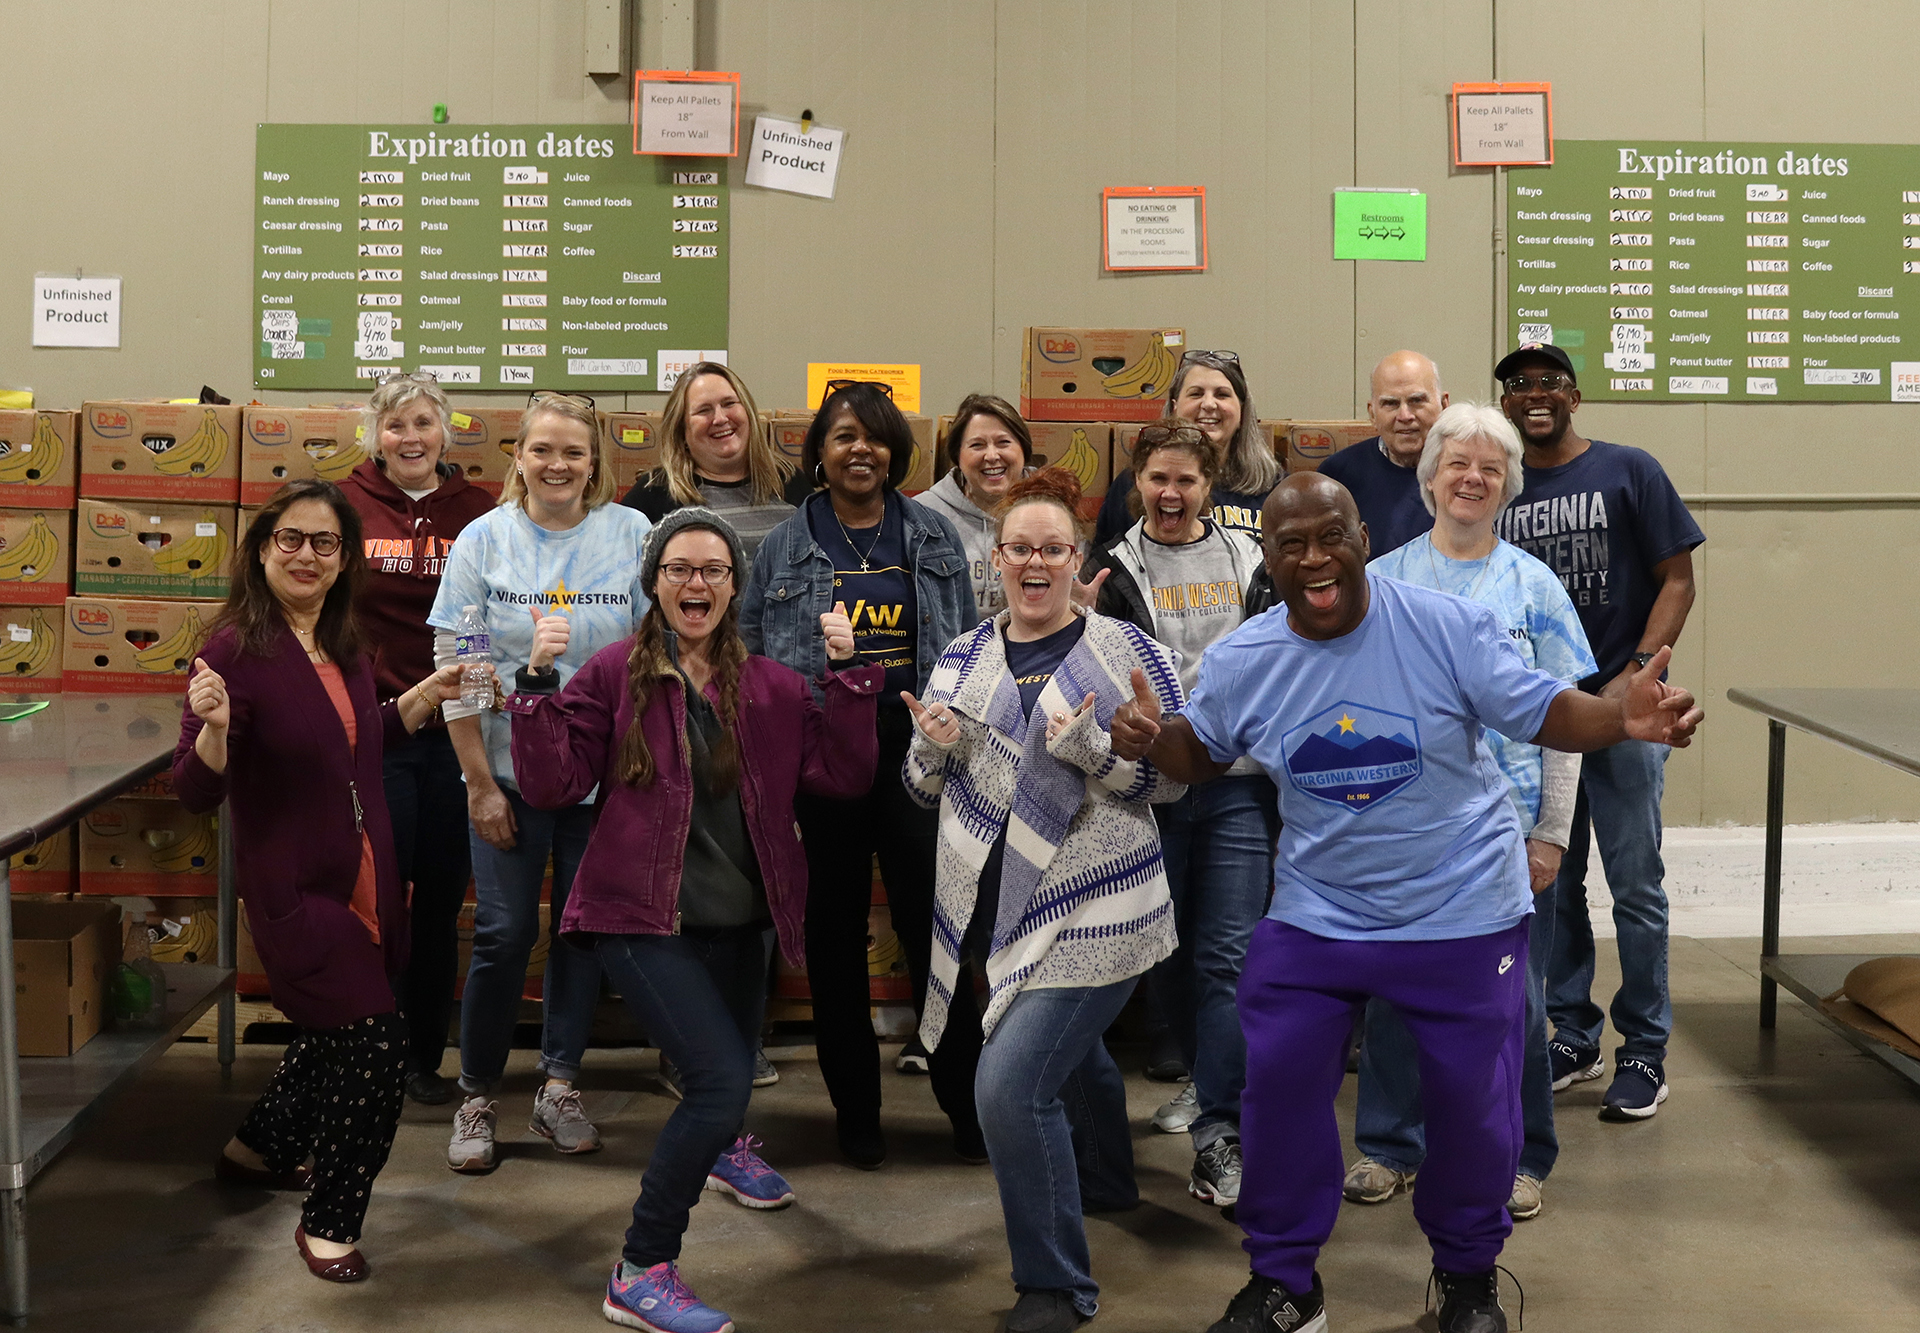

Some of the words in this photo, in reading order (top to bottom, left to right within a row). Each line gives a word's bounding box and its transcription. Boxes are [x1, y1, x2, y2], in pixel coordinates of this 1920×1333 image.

[651, 96, 674, 104] Keep
[677, 96, 688, 104] All
[691, 96, 721, 106] Pallets
[1467, 107, 1489, 116] Keep
[1504, 107, 1533, 115] Pallets
[662, 130, 685, 138] From
[688, 130, 709, 139] Wall
[763, 129, 833, 151] Unfinished
[1479, 140, 1501, 148] From
[368, 131, 527, 164] Expiration
[537, 132, 614, 158] dates
[762, 150, 826, 173] Product
[1617, 148, 1768, 180] Expiration
[1777, 151, 1848, 176] dates
[263, 172, 290, 183] Mayo
[422, 172, 448, 182] Dried
[450, 172, 471, 181] fruit
[563, 173, 590, 182] Juice
[1517, 187, 1543, 198] Mayo
[1669, 188, 1694, 198] Dried
[1696, 189, 1716, 198] fruit
[1802, 190, 1827, 199] Juice
[263, 196, 294, 205] Ranch
[297, 197, 340, 208] dressing
[421, 197, 448, 206] Dried
[450, 197, 480, 206] beans
[563, 198, 601, 207] Canned
[604, 198, 633, 207] foods
[1361, 214, 1404, 223] Restrooms
[1517, 211, 1548, 220] Ranch
[1550, 211, 1592, 222] dressing
[1669, 213, 1694, 221] Dried
[1696, 213, 1725, 221] beans
[1802, 214, 1838, 223] Canned
[1840, 215, 1866, 223] foods
[262, 221, 297, 230] Caesar
[300, 221, 342, 232] dressing
[421, 221, 449, 231] Pasta
[563, 222, 593, 233] Sugar
[1517, 235, 1551, 244] Caesar
[1553, 236, 1594, 246] dressing
[1669, 237, 1696, 246] Pasta
[1802, 238, 1830, 248] Sugar
[262, 245, 302, 255] Tortillas
[421, 246, 443, 255] Rice
[563, 247, 596, 256] Coffee
[1517, 260, 1556, 269] Tortillas
[1670, 261, 1690, 269] Rice
[1802, 262, 1833, 271] Coffee
[262, 270, 282, 281] Any
[284, 270, 308, 281] dairy
[312, 271, 355, 281] products
[420, 271, 448, 280] Salad
[450, 271, 499, 282] dressings
[623, 272, 661, 283] Discard
[1517, 284, 1536, 295] Any
[1539, 284, 1563, 295] dairy
[1566, 285, 1607, 295] products
[1669, 285, 1696, 294] Salad
[1698, 285, 1743, 296] dressings
[1858, 287, 1893, 297] Discard
[43, 289, 112, 301] Unfinished
[262, 295, 293, 304] Cereal
[420, 296, 461, 305] Oatmeal
[562, 296, 588, 307] Baby
[590, 297, 613, 306] food
[629, 297, 667, 306] formula
[46, 309, 108, 323] Product
[1517, 309, 1548, 317] Cereal
[1669, 309, 1708, 318] Oatmeal
[1803, 310, 1826, 320] Baby
[1829, 310, 1850, 319] food
[1864, 311, 1899, 319] formula
[419, 320, 463, 331] Jam/jelly
[562, 321, 621, 331] Non-labeled
[624, 322, 669, 332] products
[1669, 334, 1711, 344] Jam/jelly
[1803, 335, 1858, 343] Non-labeled
[1860, 335, 1901, 345] products
[420, 345, 454, 354] Peanut
[456, 345, 486, 354] butter
[562, 346, 588, 355] Flour
[1046, 339, 1076, 353] Dole
[1670, 358, 1703, 366] Peanut
[1705, 358, 1733, 366] butter
[1803, 358, 1828, 367] Flour
[261, 369, 275, 378] Oil
[97, 413, 127, 427] Dole
[256, 420, 286, 433] Dole
[145, 440, 168, 450] MIX
[1300, 434, 1331, 447] Dole
[96, 513, 125, 527] Dole
[496, 591, 559, 605] VIRGINIA
[562, 594, 629, 605] WESTERN
[79, 609, 109, 623] Dole
[1200, 605, 1232, 617] COLLEGE
[1016, 674, 1052, 685] WEST
[1295, 772, 1355, 786] VIRGINIA
[1357, 762, 1419, 781] WESTERN
